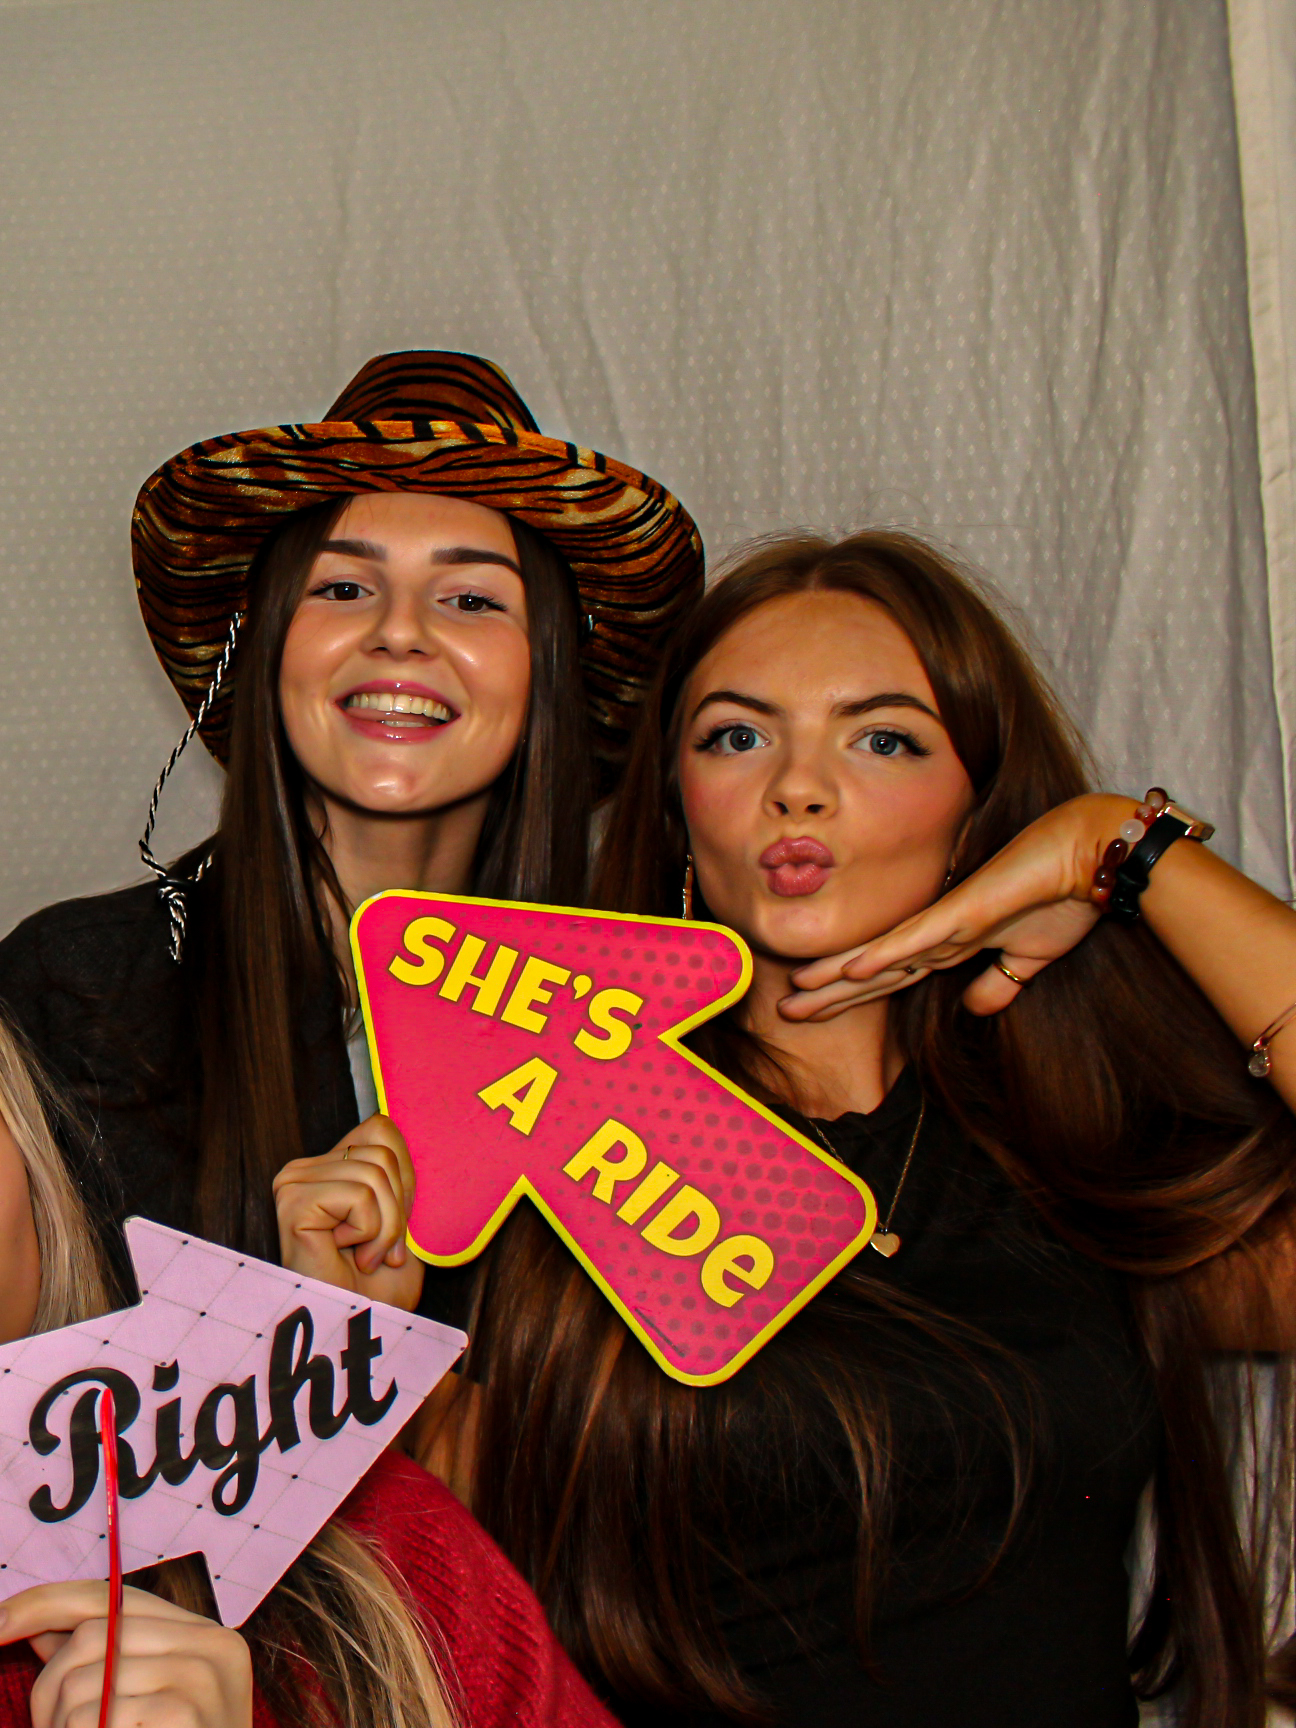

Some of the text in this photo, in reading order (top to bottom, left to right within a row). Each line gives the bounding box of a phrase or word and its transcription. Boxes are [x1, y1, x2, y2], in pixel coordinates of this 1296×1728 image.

[388, 916, 644, 1060] SHE'S
[477, 1057, 558, 1136] A
[29, 1306, 398, 1523] Right
